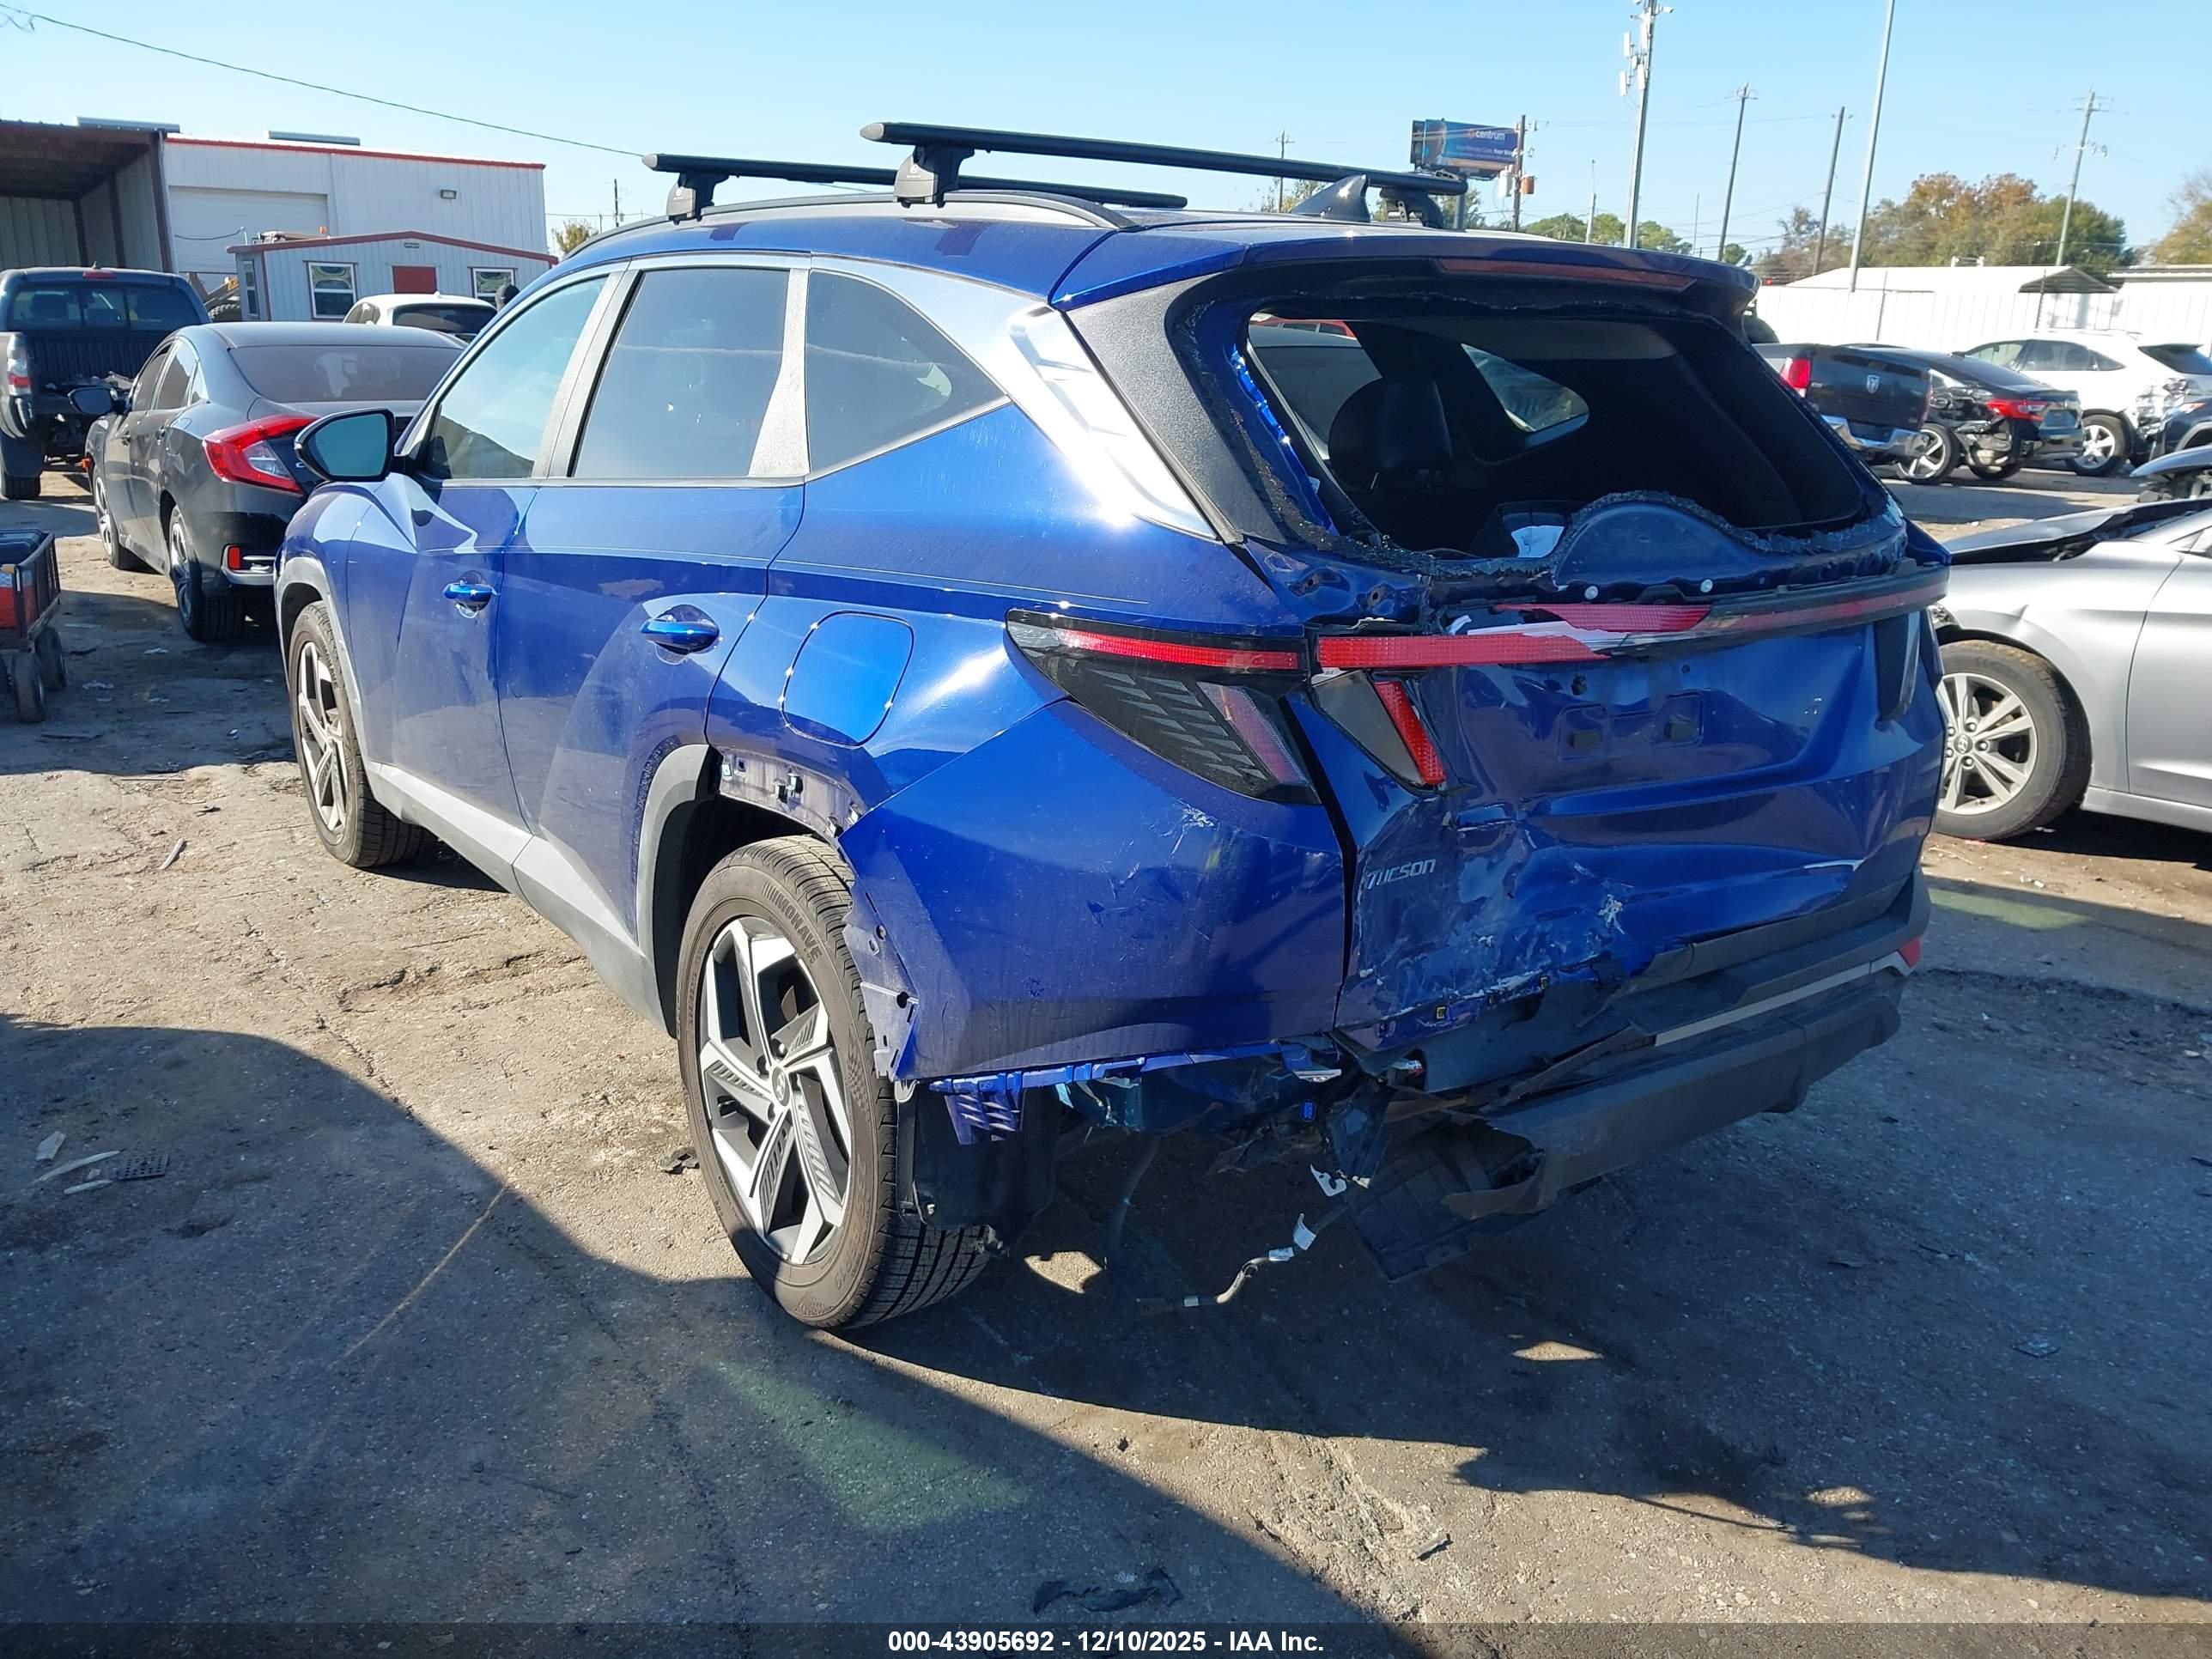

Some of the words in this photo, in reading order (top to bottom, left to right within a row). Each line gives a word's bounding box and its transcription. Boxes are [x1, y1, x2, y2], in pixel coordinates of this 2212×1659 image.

[1475, 131, 1505, 141] centrum
[1366, 858, 1437, 890] TUCSON
[774, 892, 823, 962] MOHAVE
